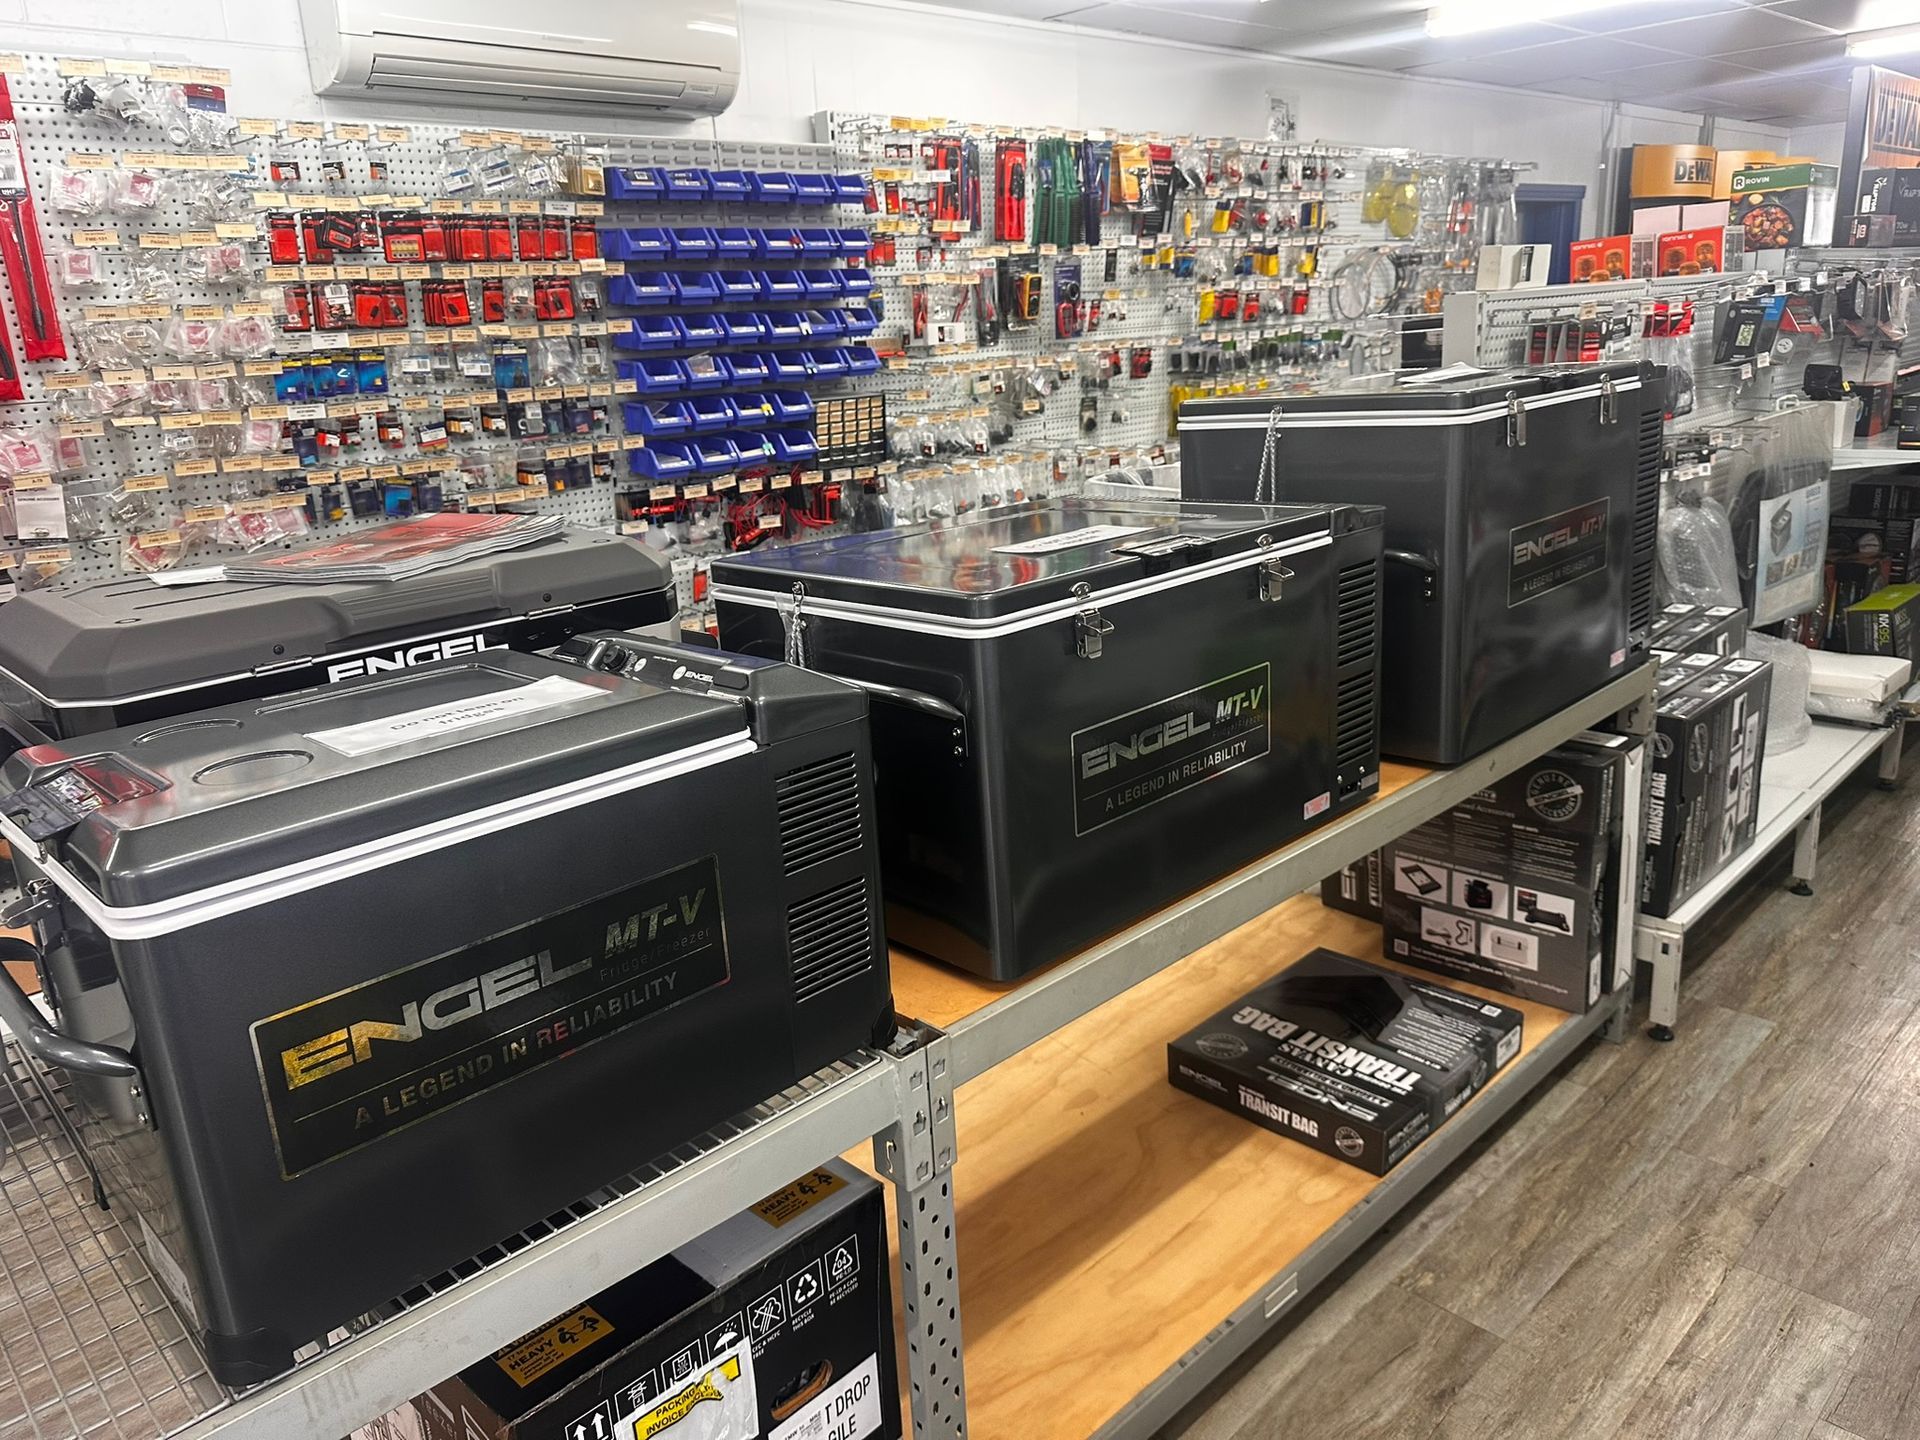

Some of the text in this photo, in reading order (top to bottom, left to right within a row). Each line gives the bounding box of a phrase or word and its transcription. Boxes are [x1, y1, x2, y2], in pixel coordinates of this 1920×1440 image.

[1745, 176, 1770, 185] ROVIN
[1513, 527, 1578, 565] ENGEL
[327, 634, 509, 682] ENGEL
[1082, 685, 1263, 779] ENGEL MT-V
[1105, 740, 1247, 812] A LEGEND IN RELIABILITY
[1647, 772, 1667, 846] TRANSIT BAG
[600, 928, 711, 981] Fridge/Freezer
[281, 888, 706, 1091] ENGEL MT-V
[1232, 1006, 1298, 1040] BAG
[354, 971, 678, 1131] A LEGEND IN RELIABILITY
[1278, 1043, 1353, 1077] CANVAS
[1288, 1031, 1422, 1092] TRANSIT
[1238, 1090, 1292, 1127] TRANSIT
[1292, 1113, 1319, 1138] BAG
[761, 1191, 796, 1215] HEAVY
[792, 1308, 812, 1326] RECYCLE
[793, 1321, 804, 1332] THIS
[509, 1339, 554, 1371] HEAVY
[752, 1344, 763, 1353] CFC
[753, 1348, 765, 1360] FREE
[656, 1387, 695, 1418] PACKING
[836, 1375, 870, 1417] DROP
[646, 1410, 685, 1435] INVOICE
